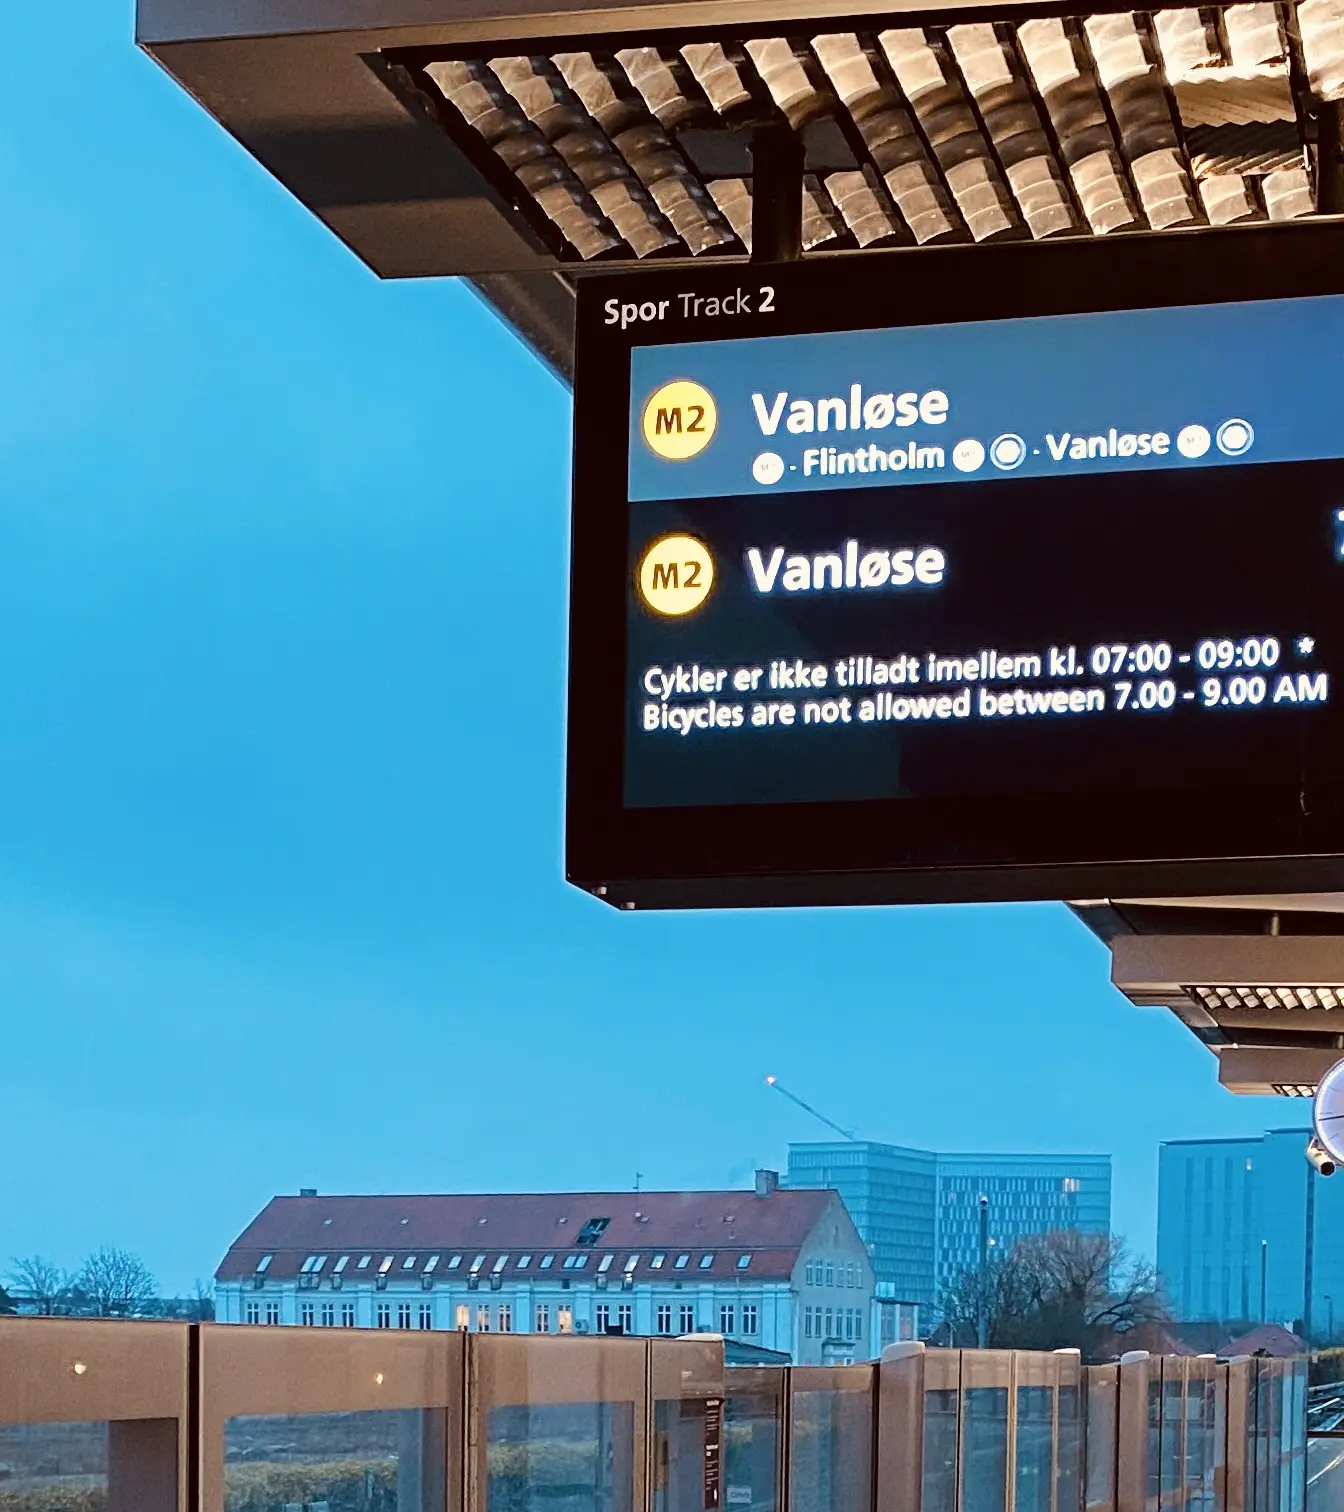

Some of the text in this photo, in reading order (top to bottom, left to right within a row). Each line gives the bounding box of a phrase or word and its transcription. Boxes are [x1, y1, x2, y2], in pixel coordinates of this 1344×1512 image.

[604, 286, 776, 330] Spor Track 2
[655, 404, 706, 436] M2
[751, 383, 949, 436] Vanløse
[803, 427, 1171, 477] Flintholm Vanløse
[652, 560, 703, 591] M2
[746, 539, 945, 593] Vanløse
[644, 664, 728, 700] Cykler
[733, 668, 764, 691] er
[769, 659, 828, 689] ikke
[834, 654, 920, 687] tilladt
[928, 649, 1041, 682] imellem
[1050, 645, 1084, 676] kl.
[1092, 643, 1172, 675] 07:00
[1198, 638, 1280, 669] 09:00
[643, 698, 745, 735] Bicycles
[751, 702, 796, 726] are
[804, 697, 852, 724] not
[858, 687, 971, 722] allowed
[979, 687, 1105, 717] between
[1114, 680, 1176, 710] 7.00
[1202, 676, 1266, 707] 9.00
[1273, 673, 1327, 703] AM
